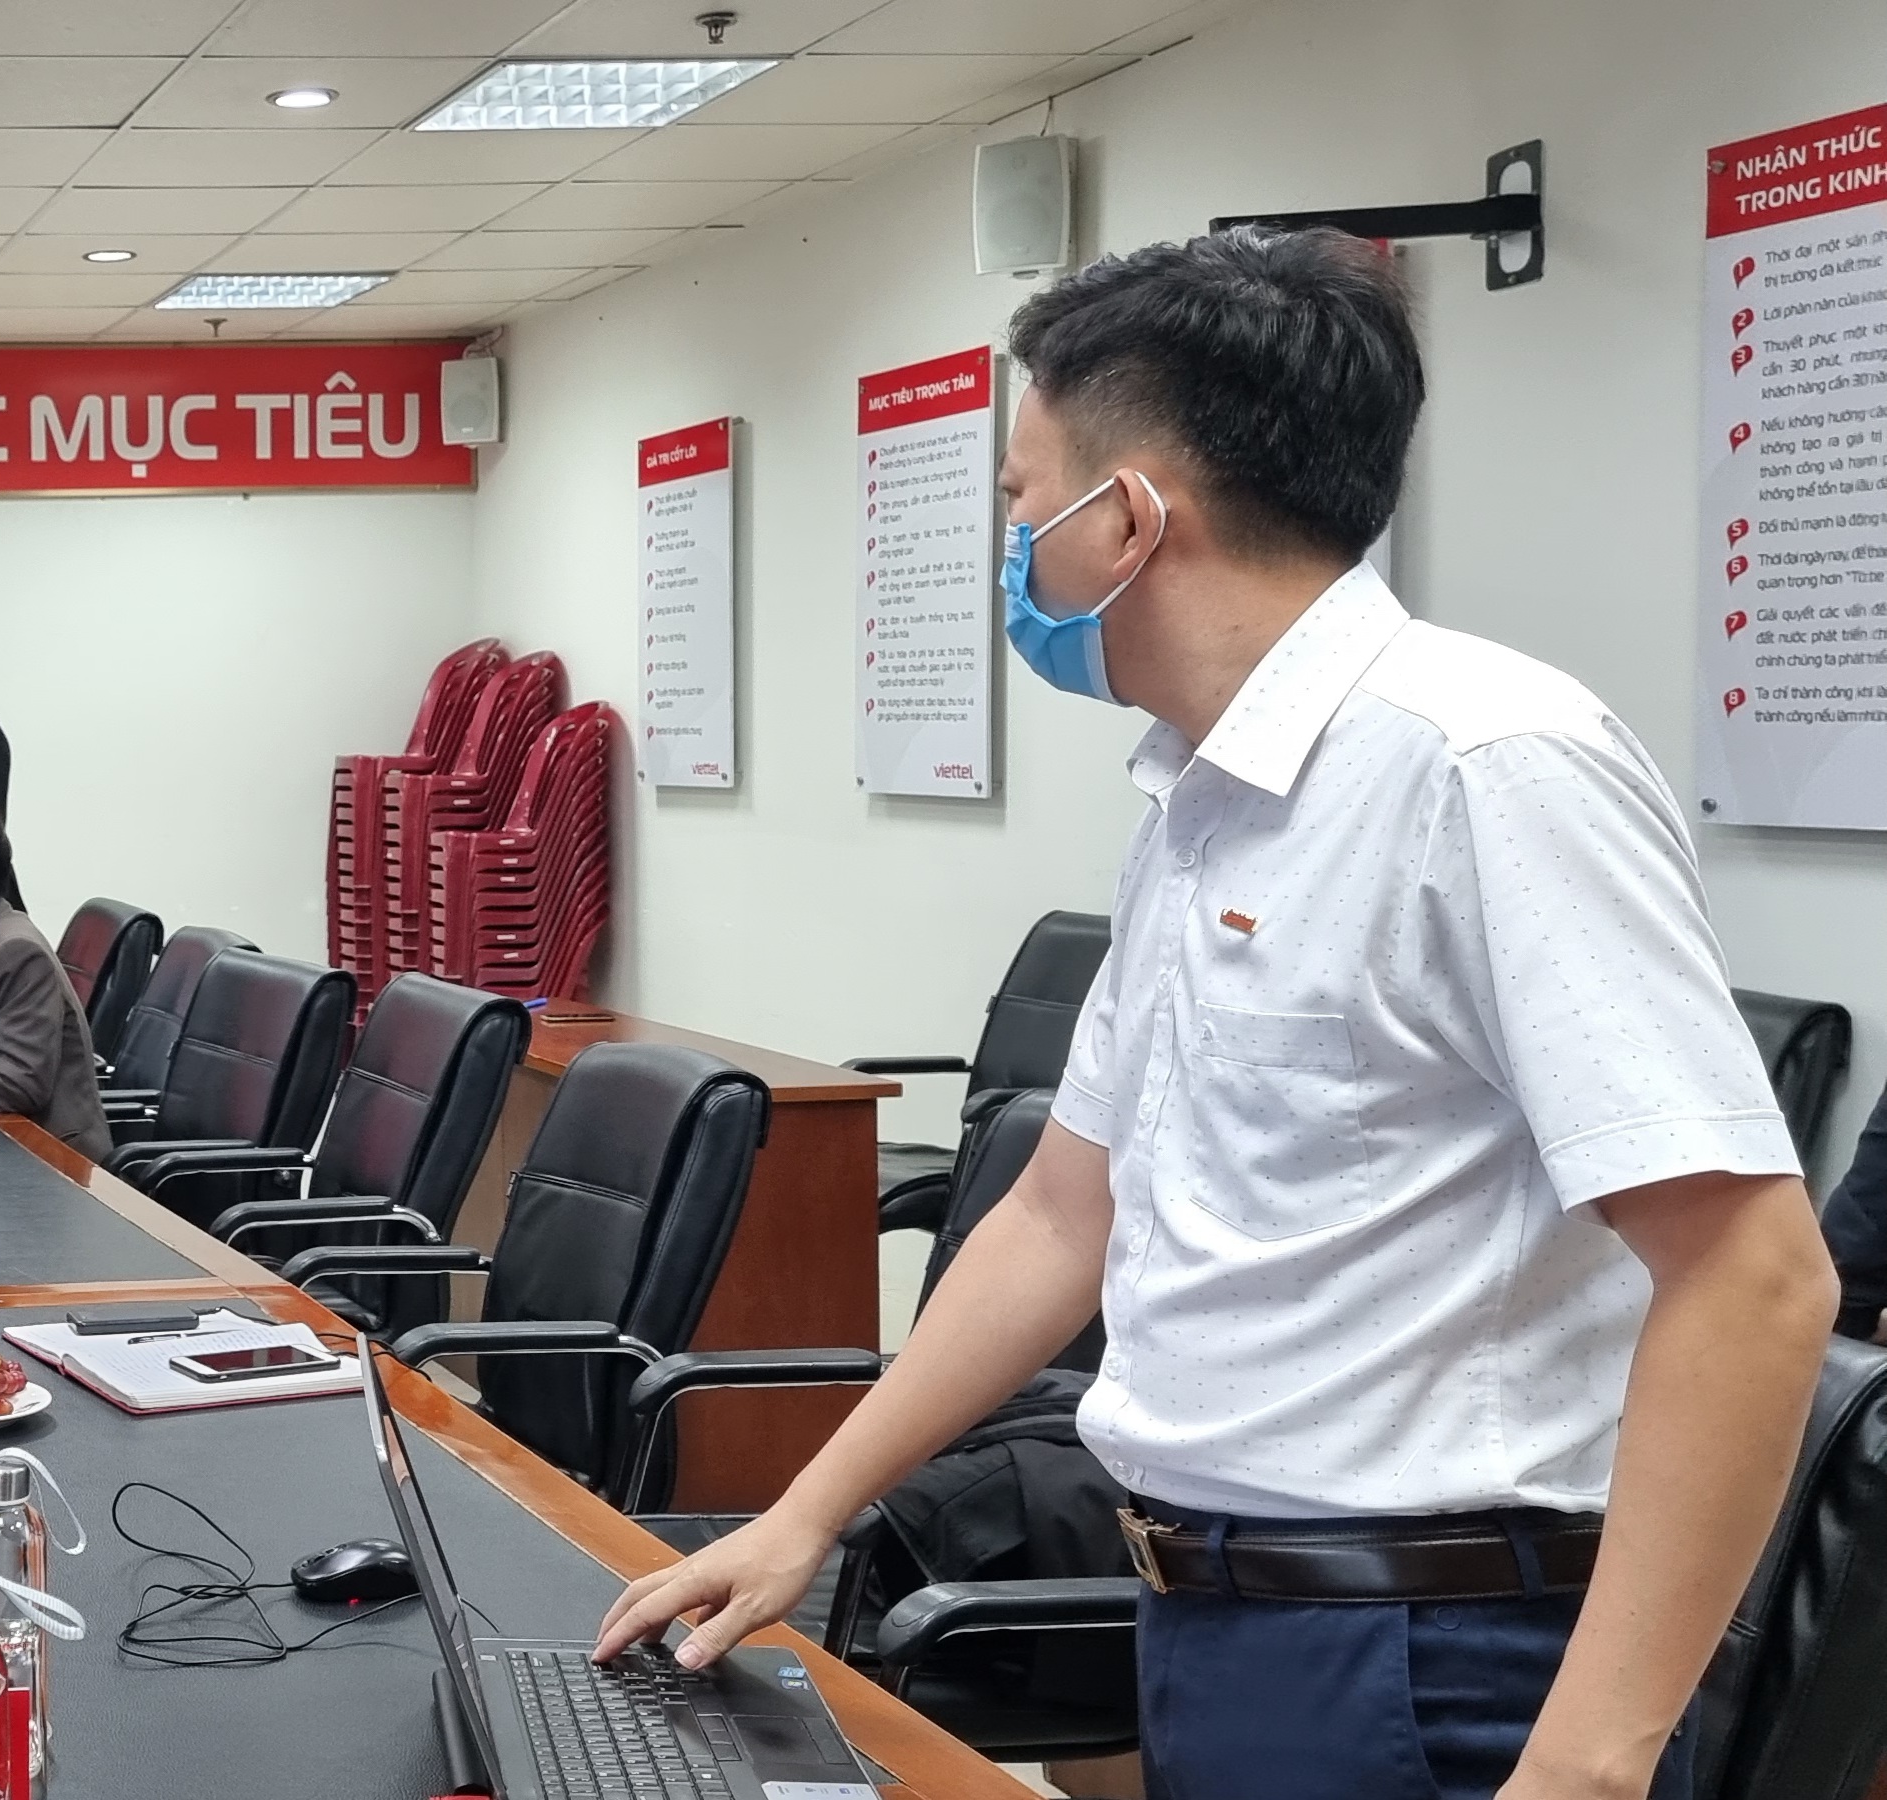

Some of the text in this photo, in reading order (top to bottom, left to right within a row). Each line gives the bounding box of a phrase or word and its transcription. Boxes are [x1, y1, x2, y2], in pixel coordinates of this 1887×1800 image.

[1736, 124, 1882, 181] NHẬN THỨC
[1734, 162, 1887, 215] TRONG KINH
[1790, 358, 1806, 373] 30
[868, 372, 975, 412] MỤC TIÊU TRỌNG TÂM
[30, 394, 218, 478] MỤC
[236, 372, 419, 459] TIÊU
[932, 762, 973, 780] viettel
